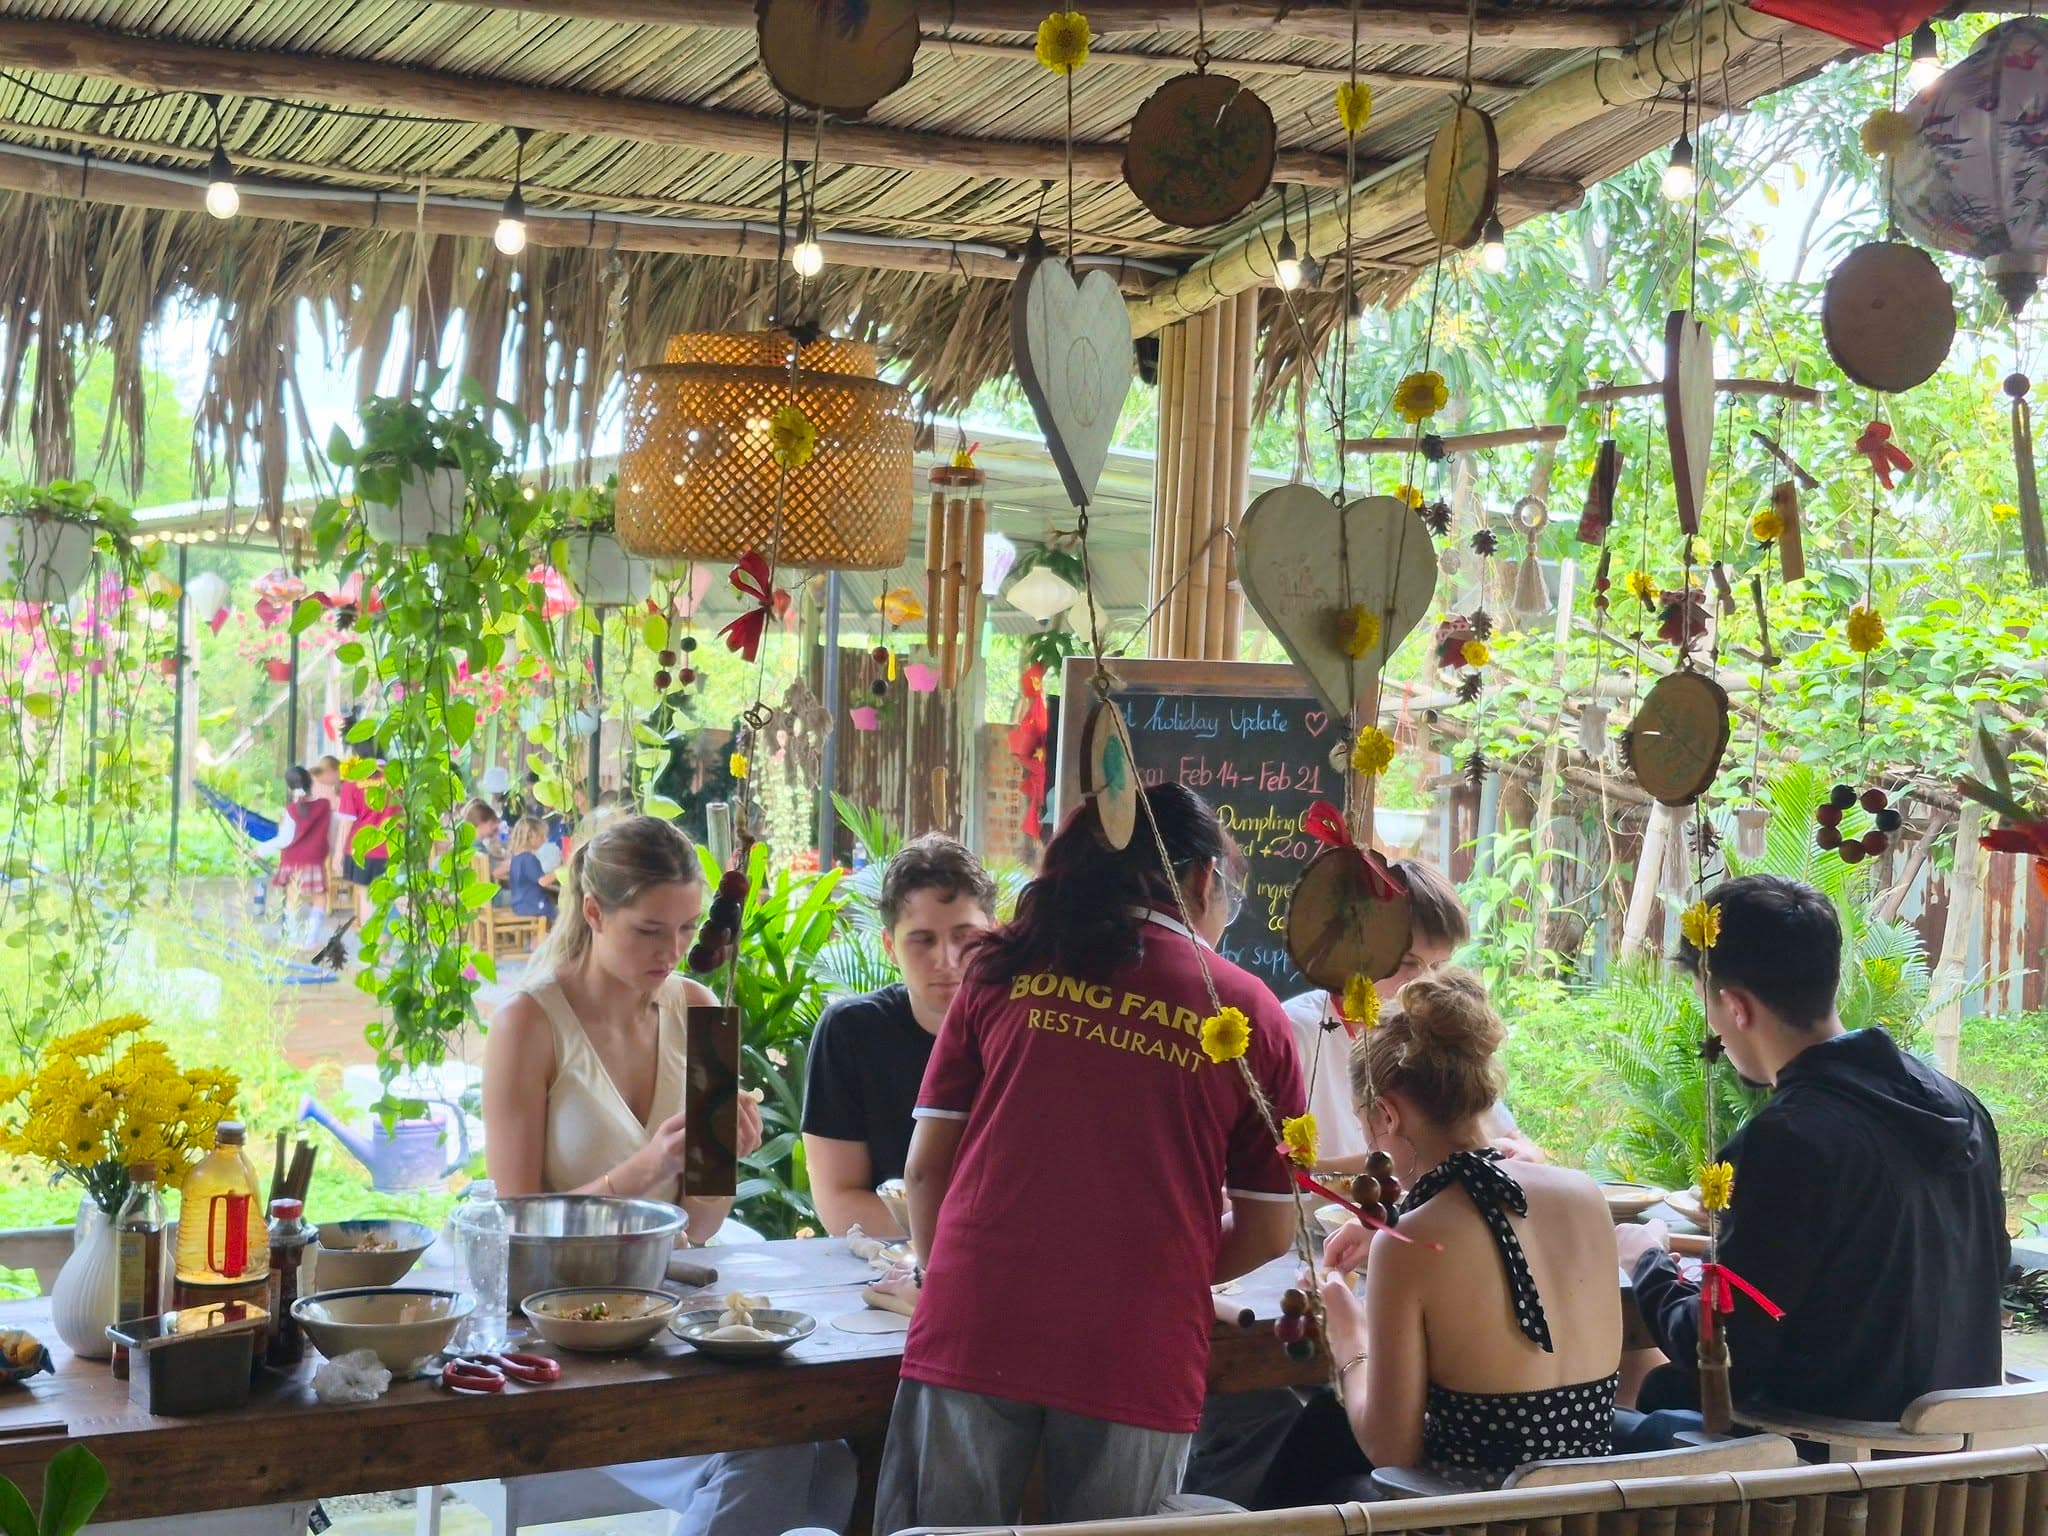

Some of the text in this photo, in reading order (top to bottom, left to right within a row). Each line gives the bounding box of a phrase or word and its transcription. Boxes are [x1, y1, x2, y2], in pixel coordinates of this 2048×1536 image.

[1144, 697, 1220, 738] holiday
[1231, 704, 1288, 738] Update
[1179, 756, 1212, 786] Feb
[1258, 762, 1291, 791] Feb
[1294, 766, 1323, 794] 21
[1028, 1008, 1205, 1073] RESTAURANT
